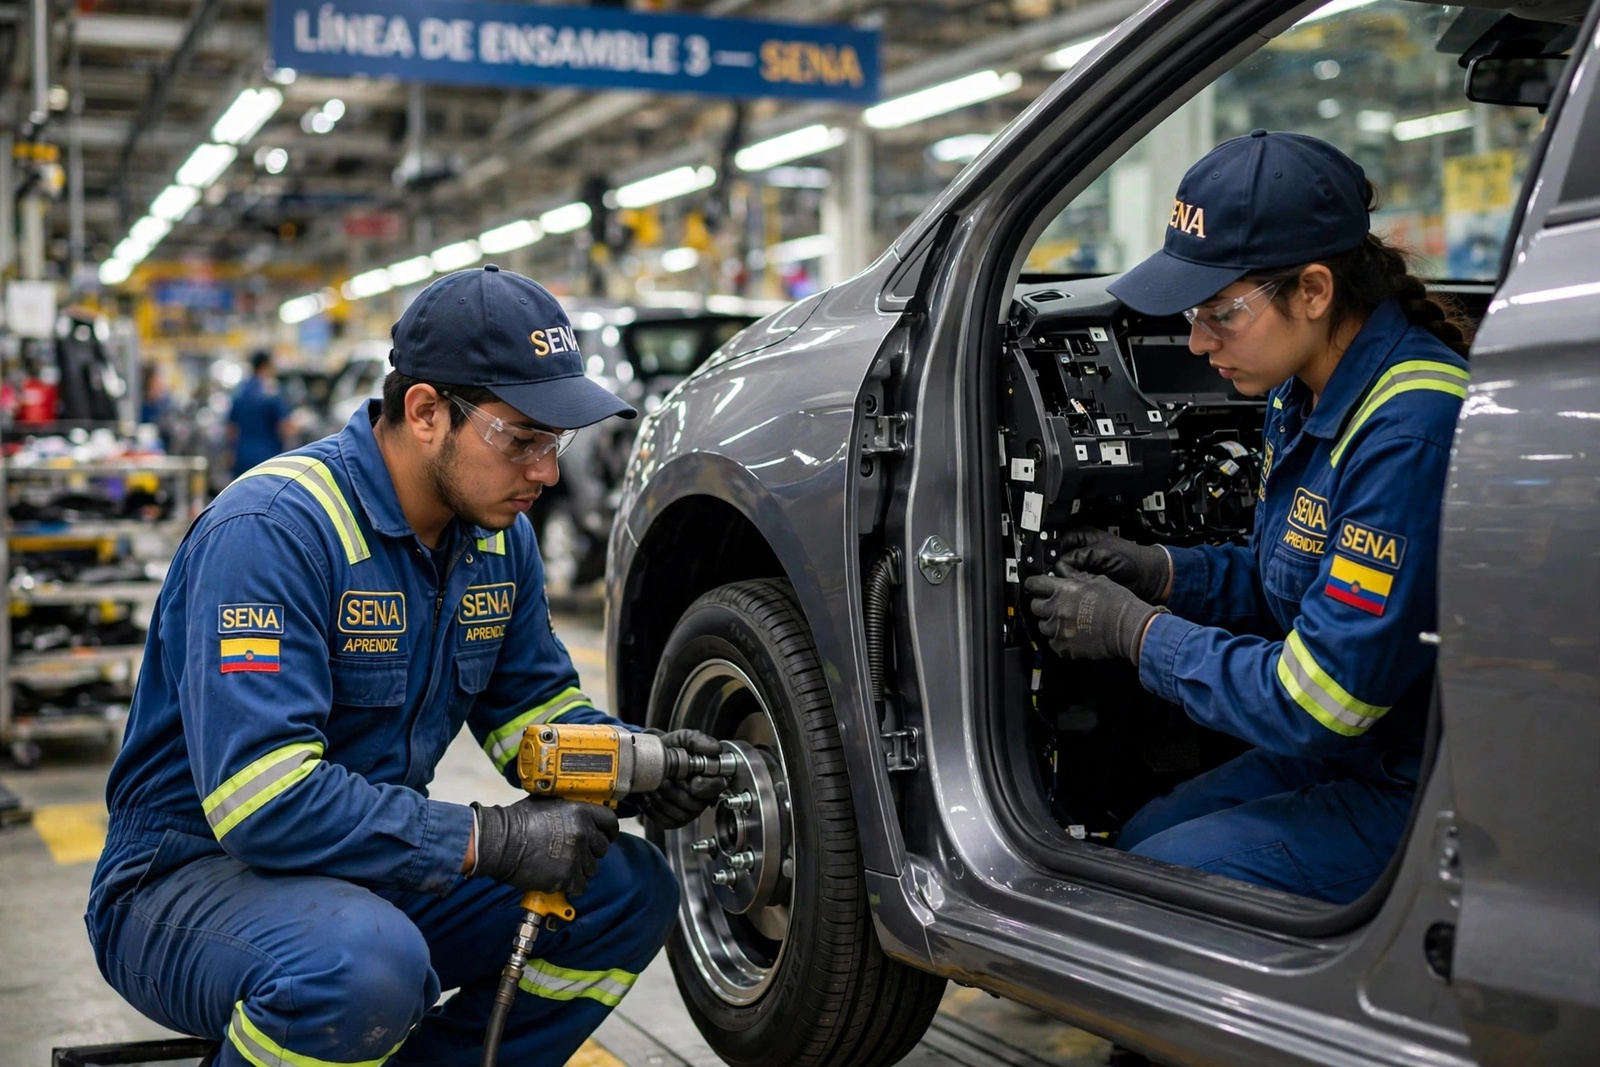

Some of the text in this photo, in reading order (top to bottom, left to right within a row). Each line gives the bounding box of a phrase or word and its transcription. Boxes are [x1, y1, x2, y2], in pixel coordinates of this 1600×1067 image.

[294, 3, 415, 59] LÍNEA
[419, 17, 475, 62] DE
[479, 21, 681, 75] ENSAMBLE
[683, 34, 711, 77] 3
[760, 40, 864, 87] SENA
[1293, 495, 1327, 531] SENA
[1282, 529, 1325, 554] APRENDIZ
[1341, 523, 1397, 564] SENA
[346, 598, 401, 627] SENA
[462, 590, 511, 617] SENA
[222, 607, 280, 629] SENA
[343, 637, 399, 652] APRENDIZ
[465, 625, 505, 641] APRENDIZ
